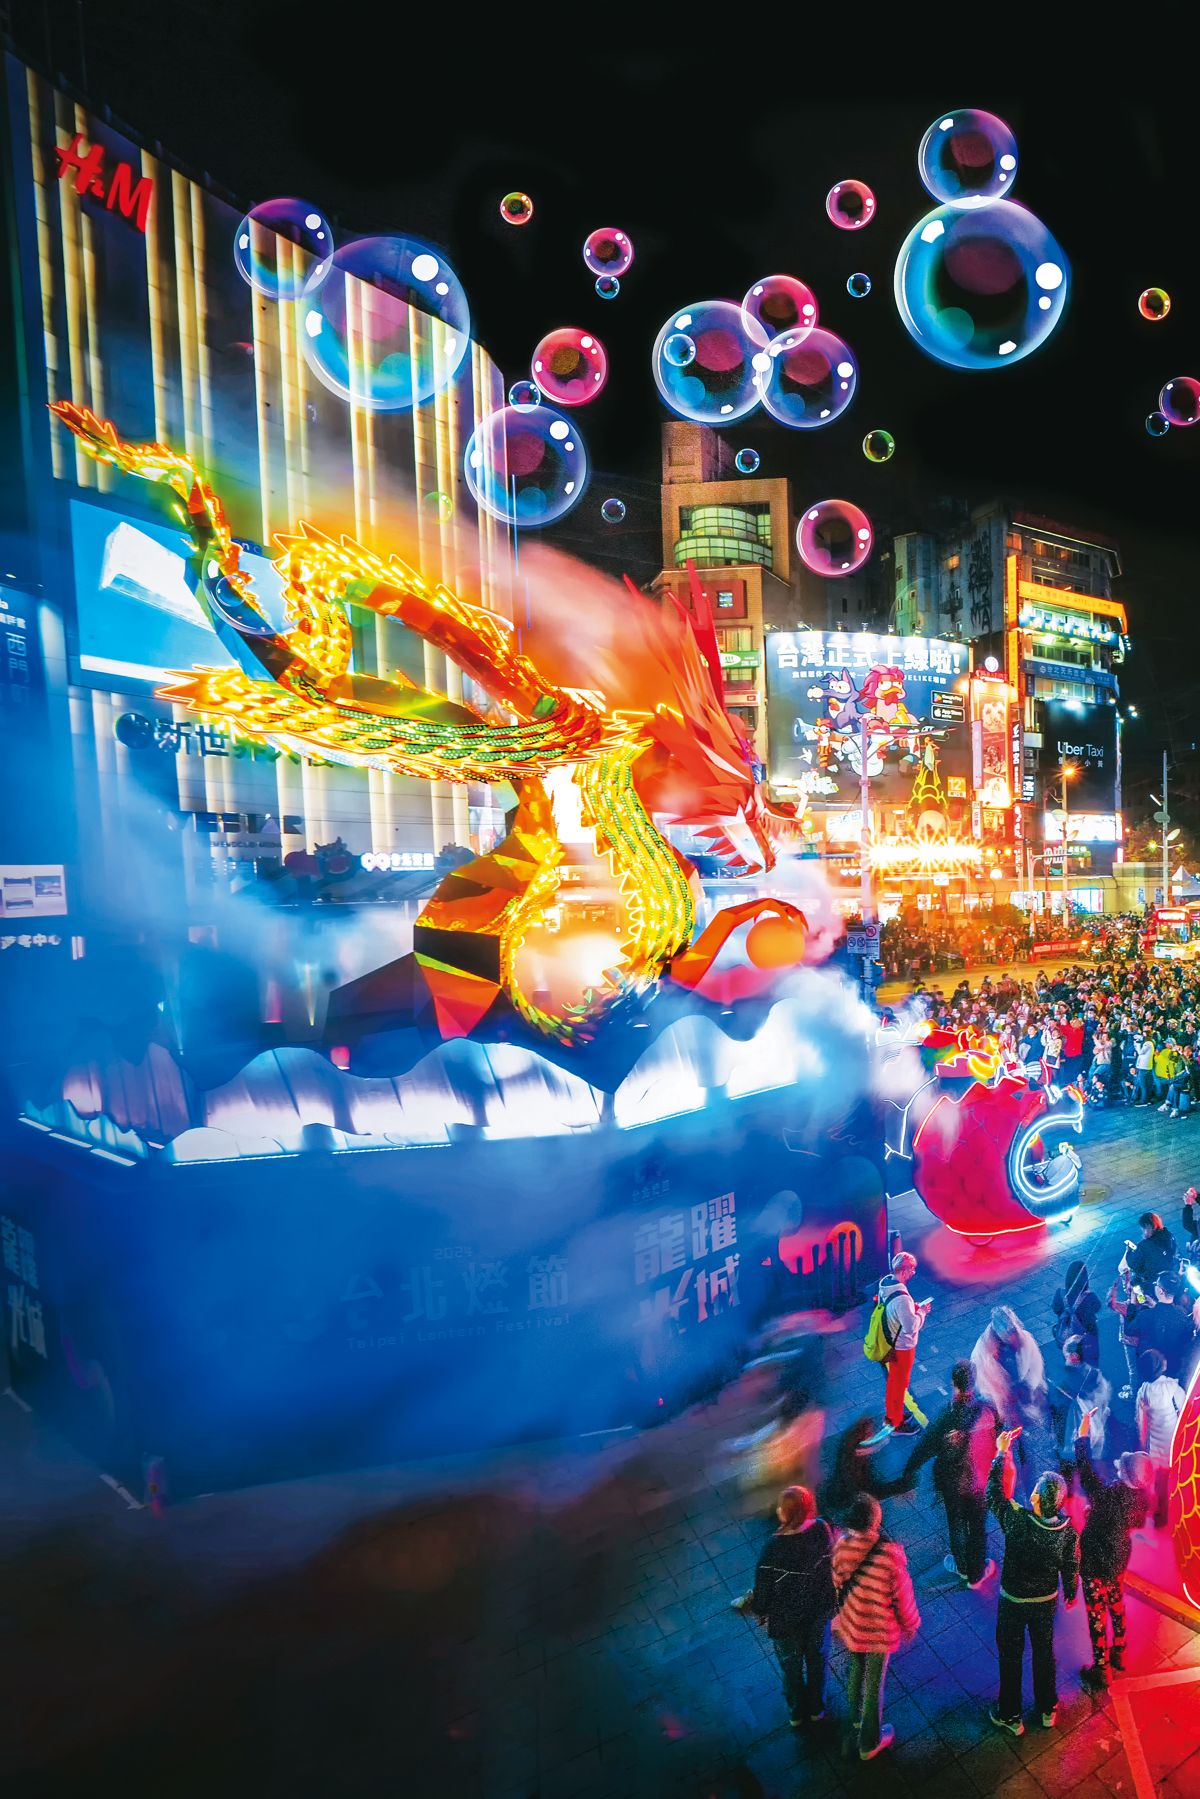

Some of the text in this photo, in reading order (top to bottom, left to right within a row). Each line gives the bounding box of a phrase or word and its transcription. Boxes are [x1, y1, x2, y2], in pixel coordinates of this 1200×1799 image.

[54, 132, 154, 233] H&M
[777, 641, 961, 675] 台灣正式上線啦!
[1057, 741, 1104, 757] Uber Taxi
[496, 1312, 572, 1332] Festival
